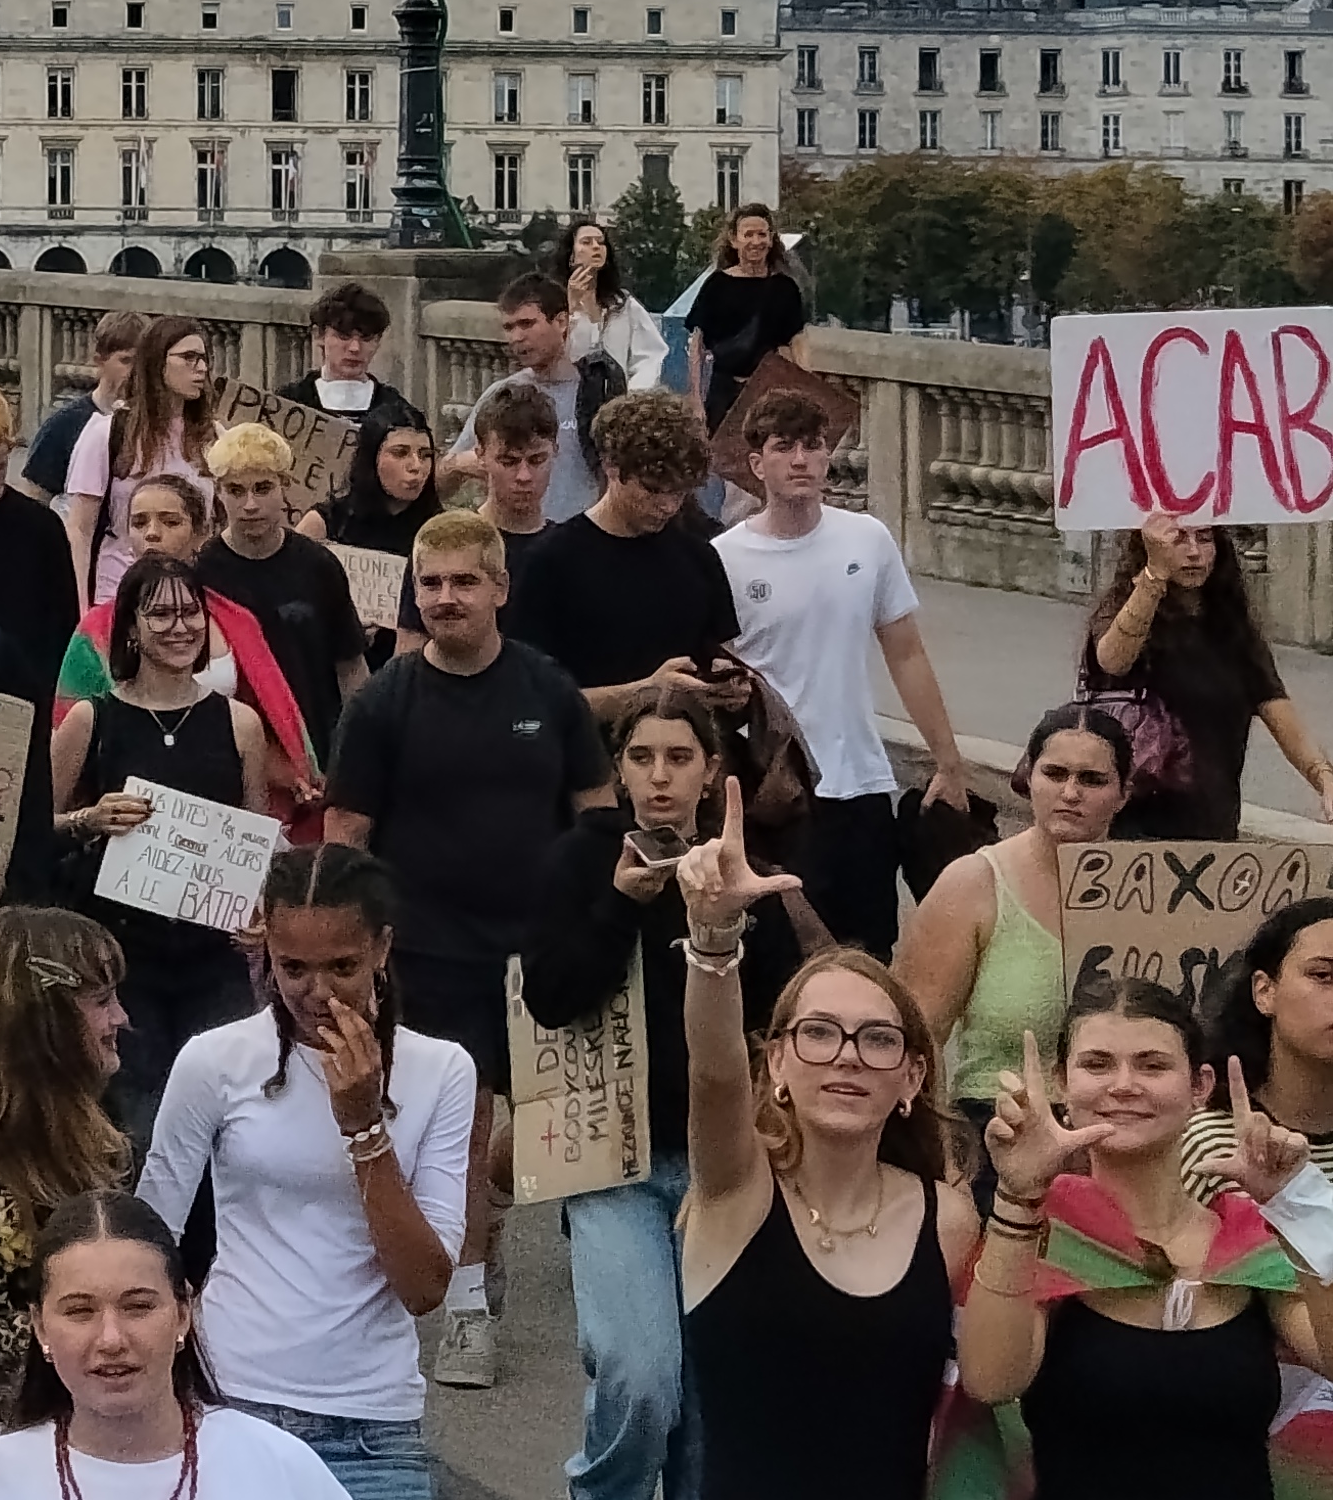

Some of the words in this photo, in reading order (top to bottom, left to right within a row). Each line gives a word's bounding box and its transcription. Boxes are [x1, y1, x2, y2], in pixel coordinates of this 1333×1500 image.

[227, 382, 330, 450] PROF
[335, 428, 361, 460] P
[1058, 325, 1333, 518] ACAB
[1064, 848, 1310, 915] BAXOA
